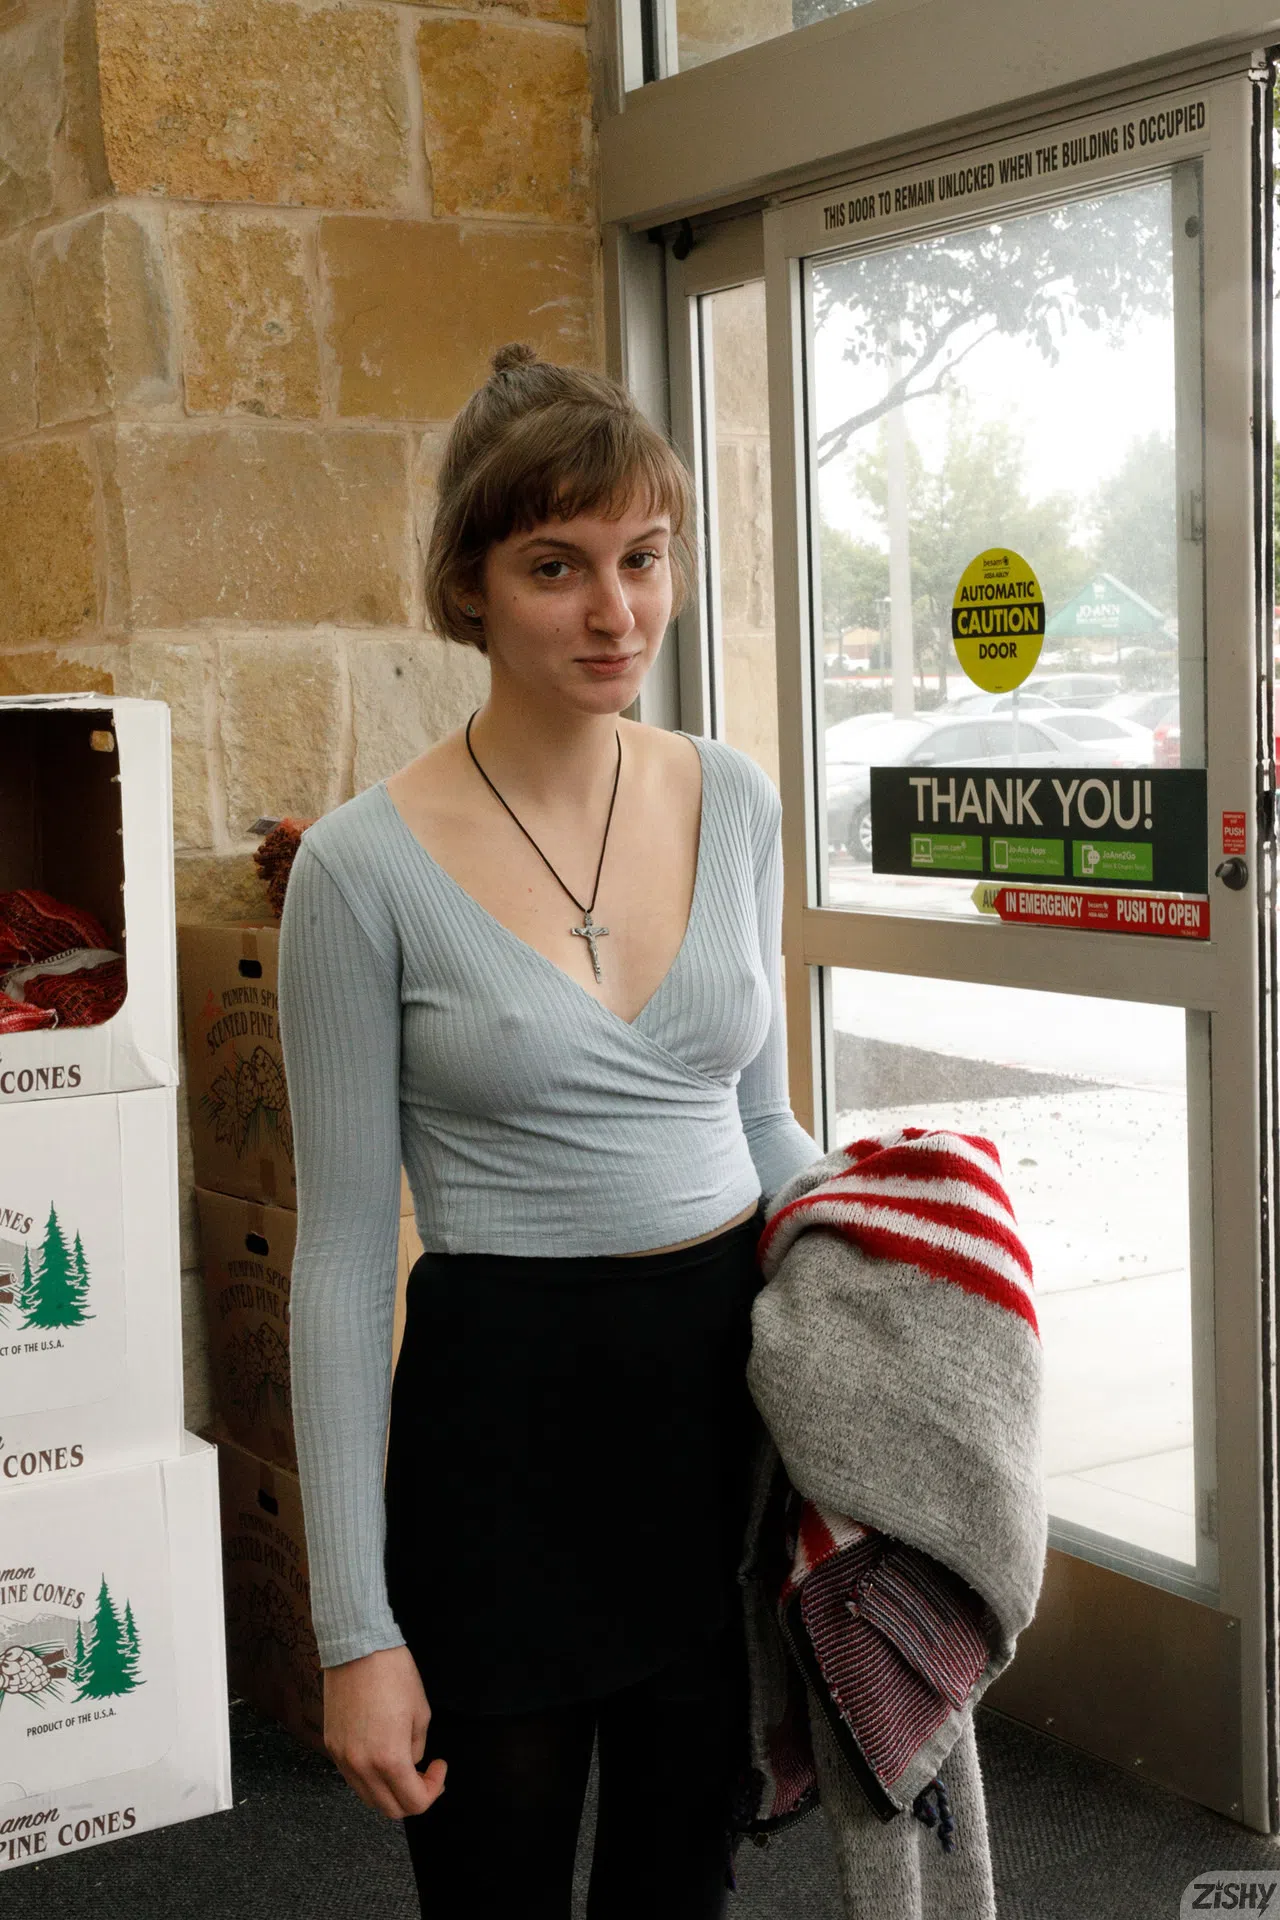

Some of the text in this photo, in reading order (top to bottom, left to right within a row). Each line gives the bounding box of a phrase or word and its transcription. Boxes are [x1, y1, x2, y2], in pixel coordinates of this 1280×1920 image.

[824, 101, 1206, 230] THIS DOOR TO REMAIN UNLOCKED WHEN THE BUILDING IS OCCUPIED
[960, 581, 1035, 602] AUTOMATIC
[957, 606, 1039, 635] CAUTION
[979, 642, 1017, 660] DOOR
[909, 777, 1153, 830] THANK YOU!
[1224, 827, 1245, 837] PUSH
[1005, 891, 1083, 918] IN EMERGENCY
[1117, 899, 1200, 927] PUSH TO OPEN
[207, 1011, 248, 1056] SCENTED
[250, 1011, 274, 1040] PINE
[1, 1064, 81, 1094] CONES
[11, 1344, 21, 1355] OF
[24, 1342, 38, 1353] THE
[41, 1339, 64, 1350] U.S.A.
[3, 1444, 84, 1478] CONES
[33, 1583, 85, 1609] CONES
[26, 1708, 117, 1737] PRODUCT OF THE U.S.A.
[58, 1807, 136, 1846] CONES
